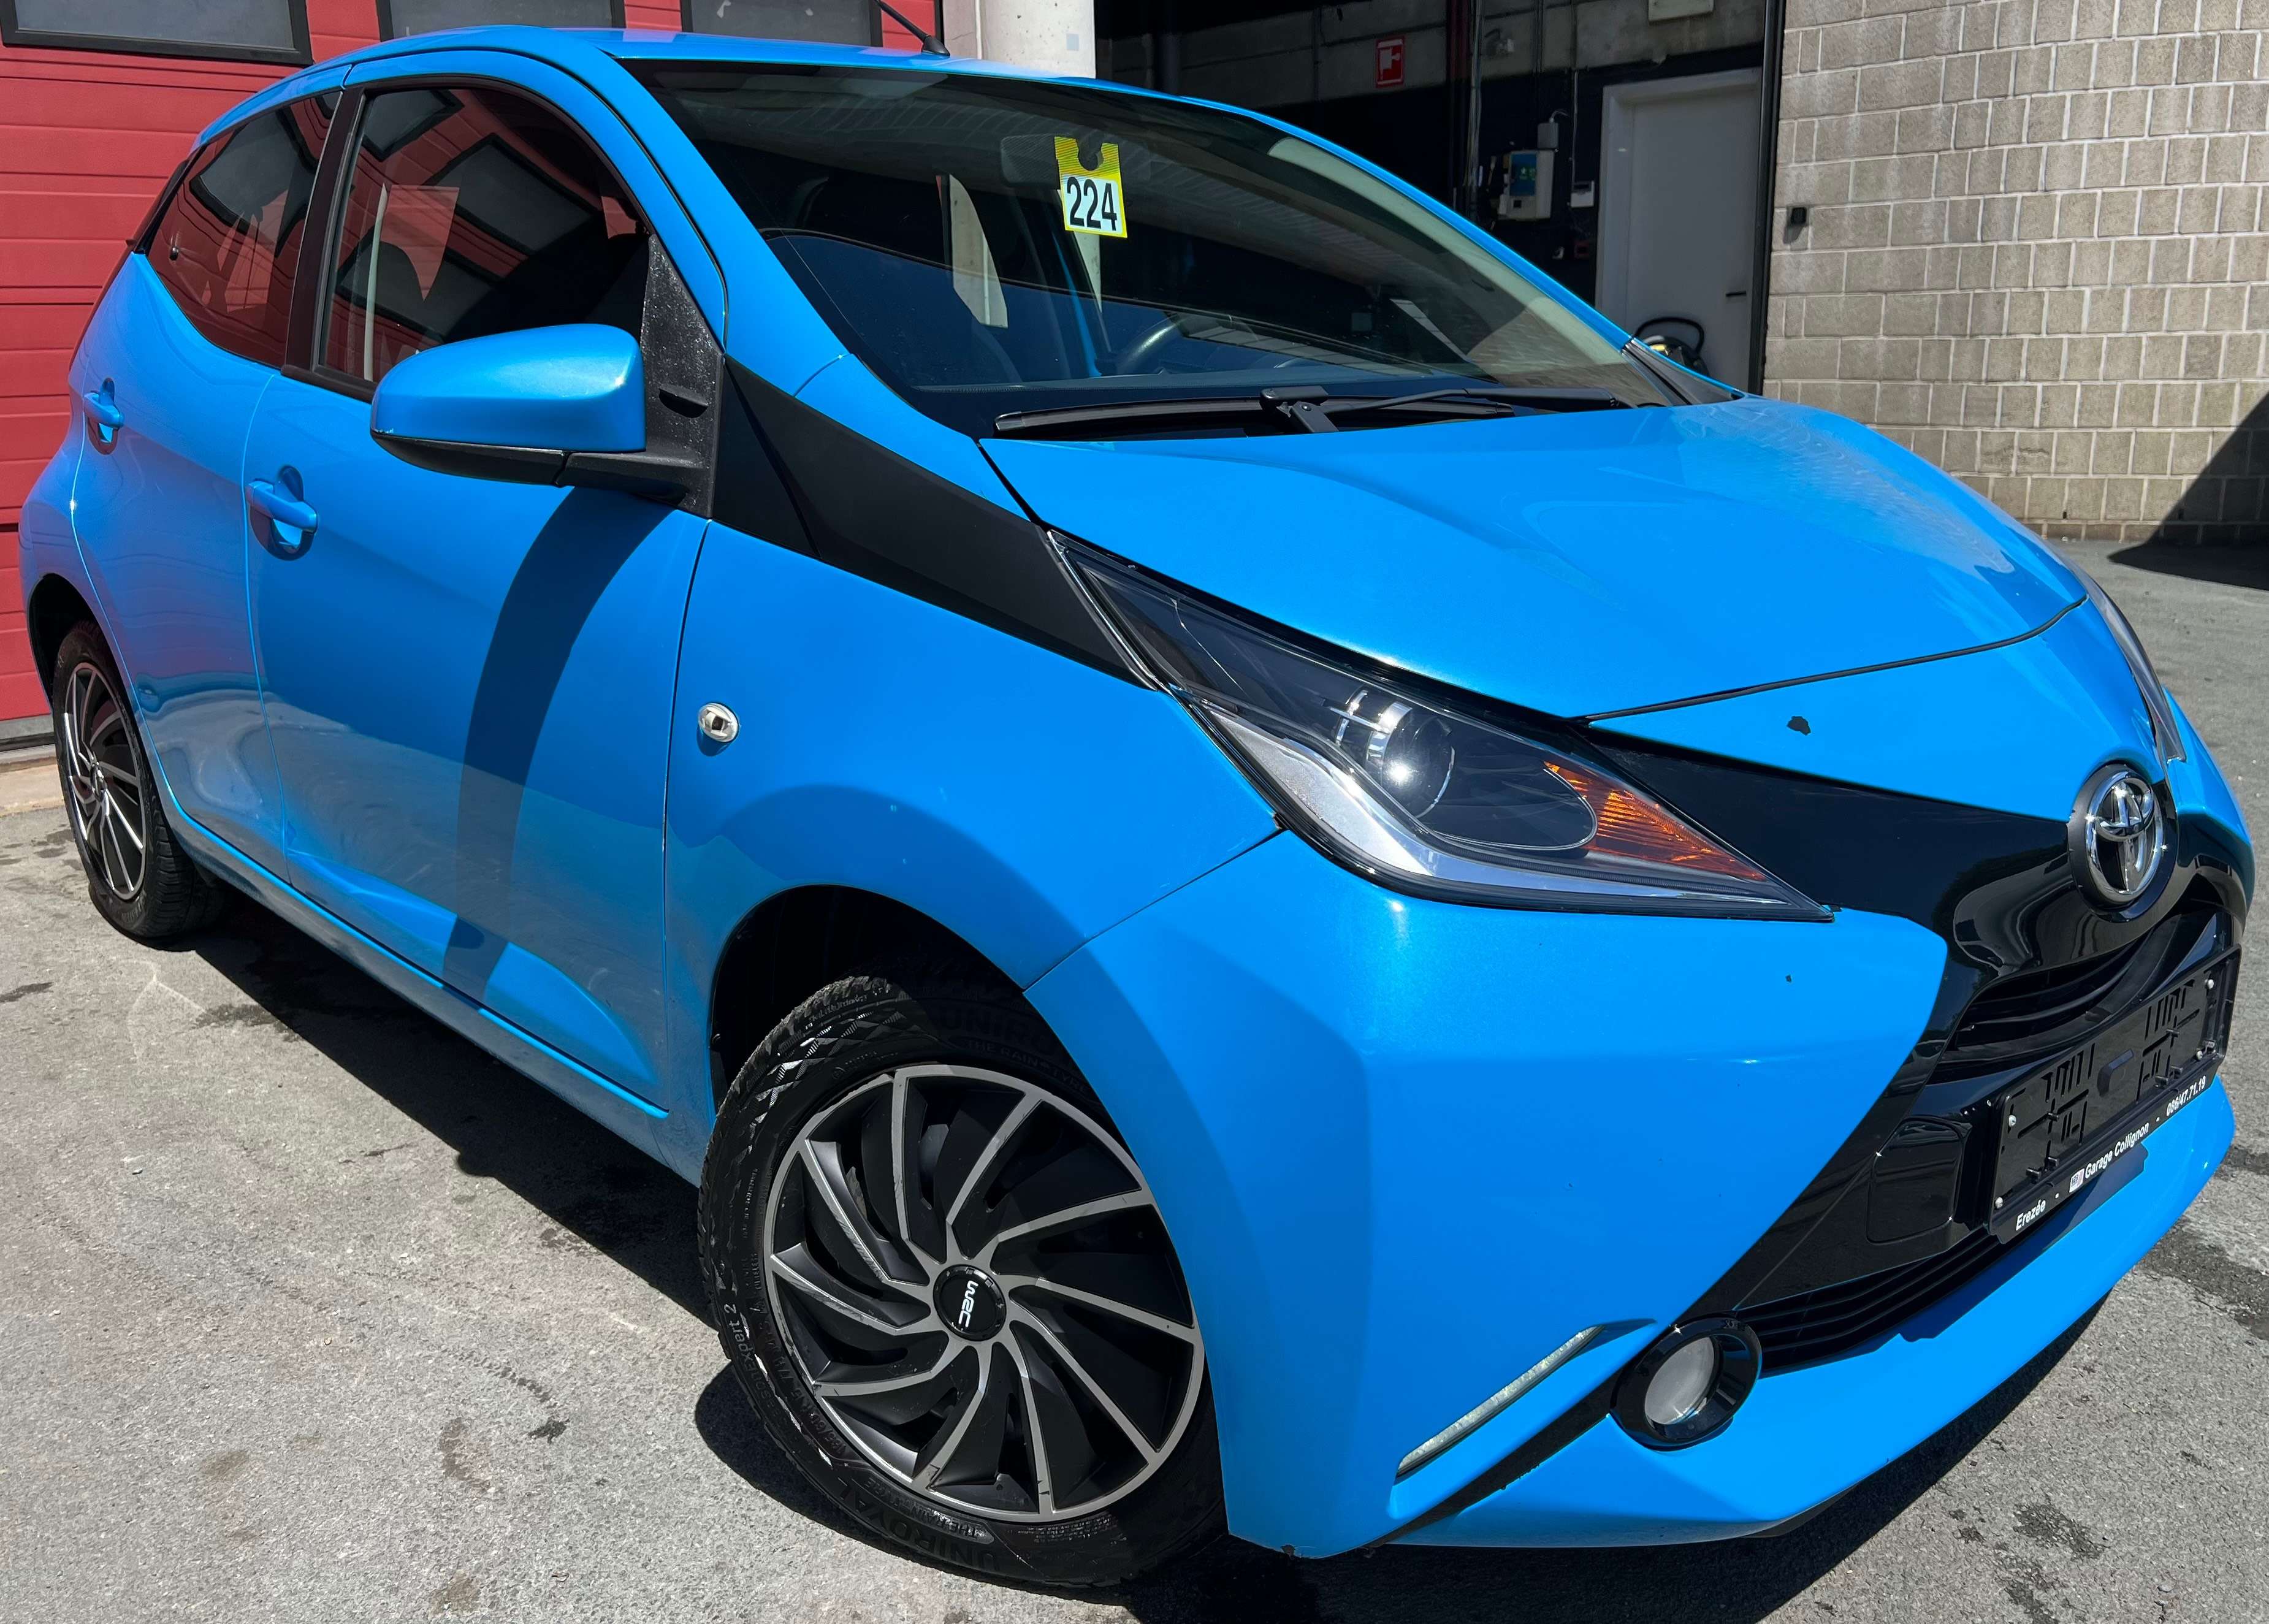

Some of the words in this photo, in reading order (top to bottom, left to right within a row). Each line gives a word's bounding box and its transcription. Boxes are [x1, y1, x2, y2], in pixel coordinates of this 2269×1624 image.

[1067, 177, 1117, 231] 224
[2016, 1199, 2046, 1231] Erezée
[2084, 1152, 2113, 1179] Garage
[2115, 1122, 2149, 1157] Collignon
[958, 1280, 978, 1328] WRC
[828, 1476, 999, 1573] UNIROYAL
[909, 1506, 945, 1528] RAIN
[948, 1519, 978, 1539] THE
